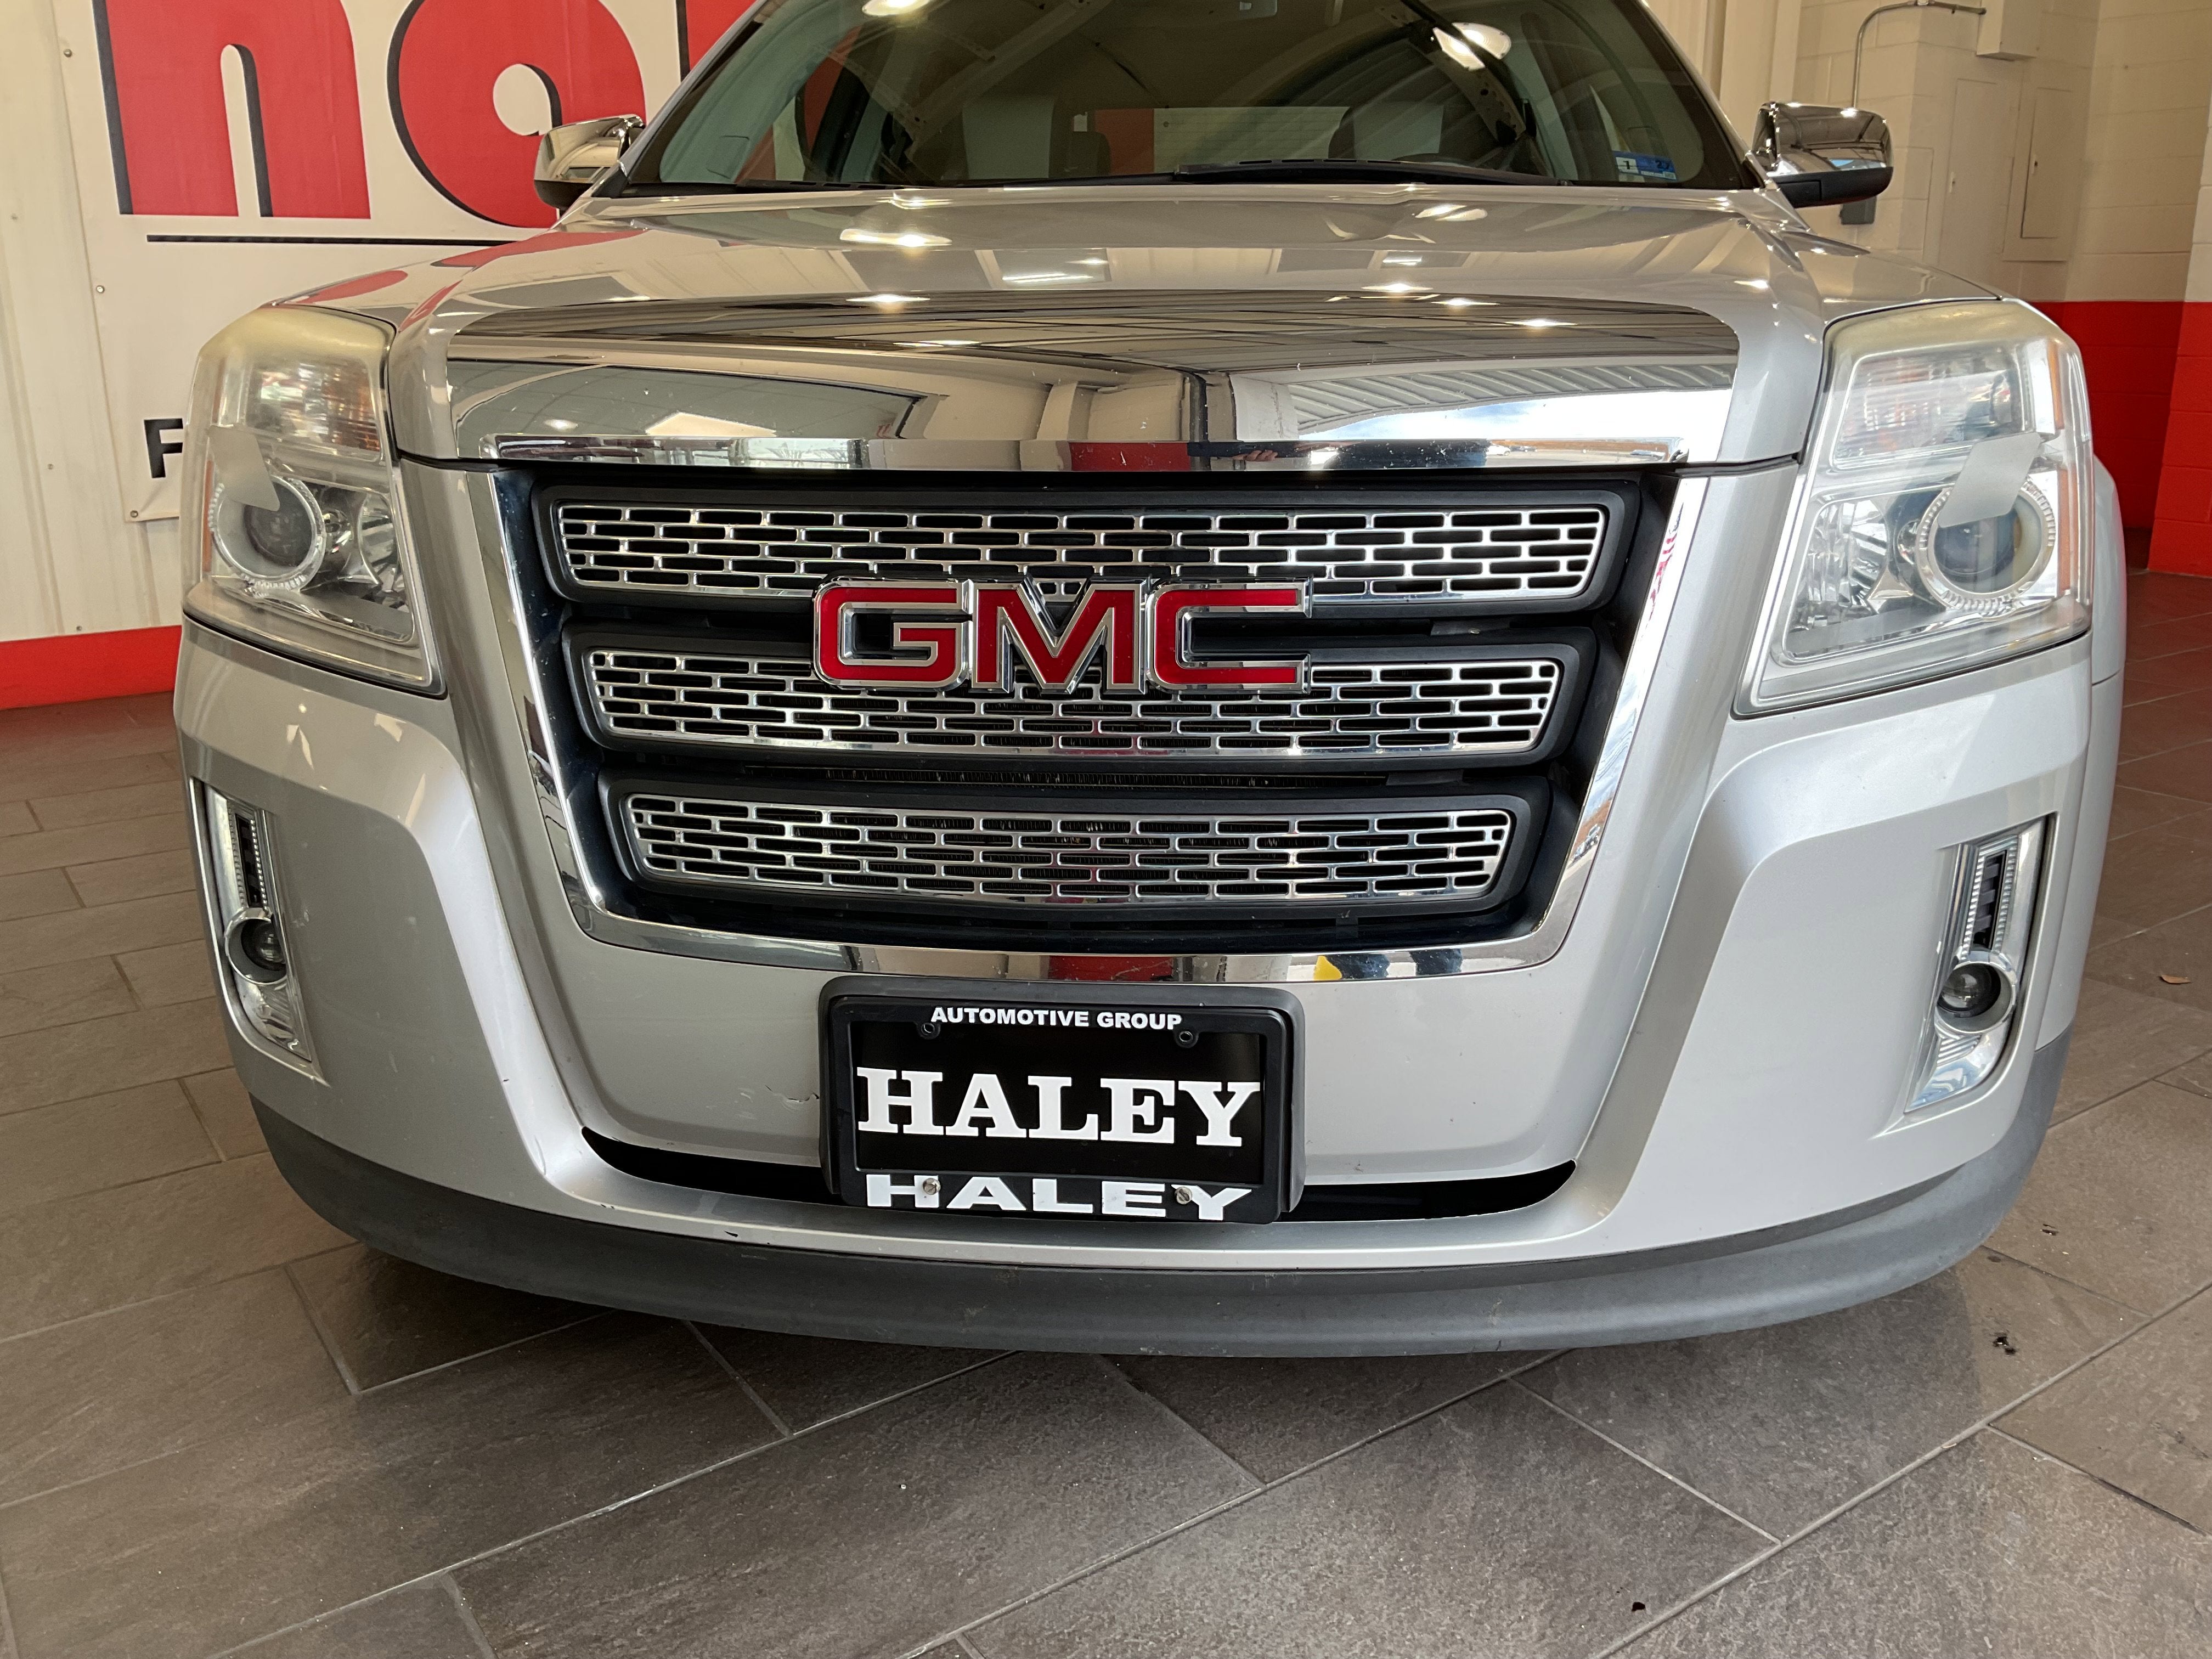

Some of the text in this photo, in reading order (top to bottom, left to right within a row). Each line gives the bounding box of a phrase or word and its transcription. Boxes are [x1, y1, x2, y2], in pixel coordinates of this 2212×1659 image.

[814, 577, 1312, 694] GMC
[931, 1006, 1182, 1030] AUTOMOTIVE GROUP
[857, 1066, 1261, 1147] HALEY
[865, 1173, 1252, 1221] HALEY
